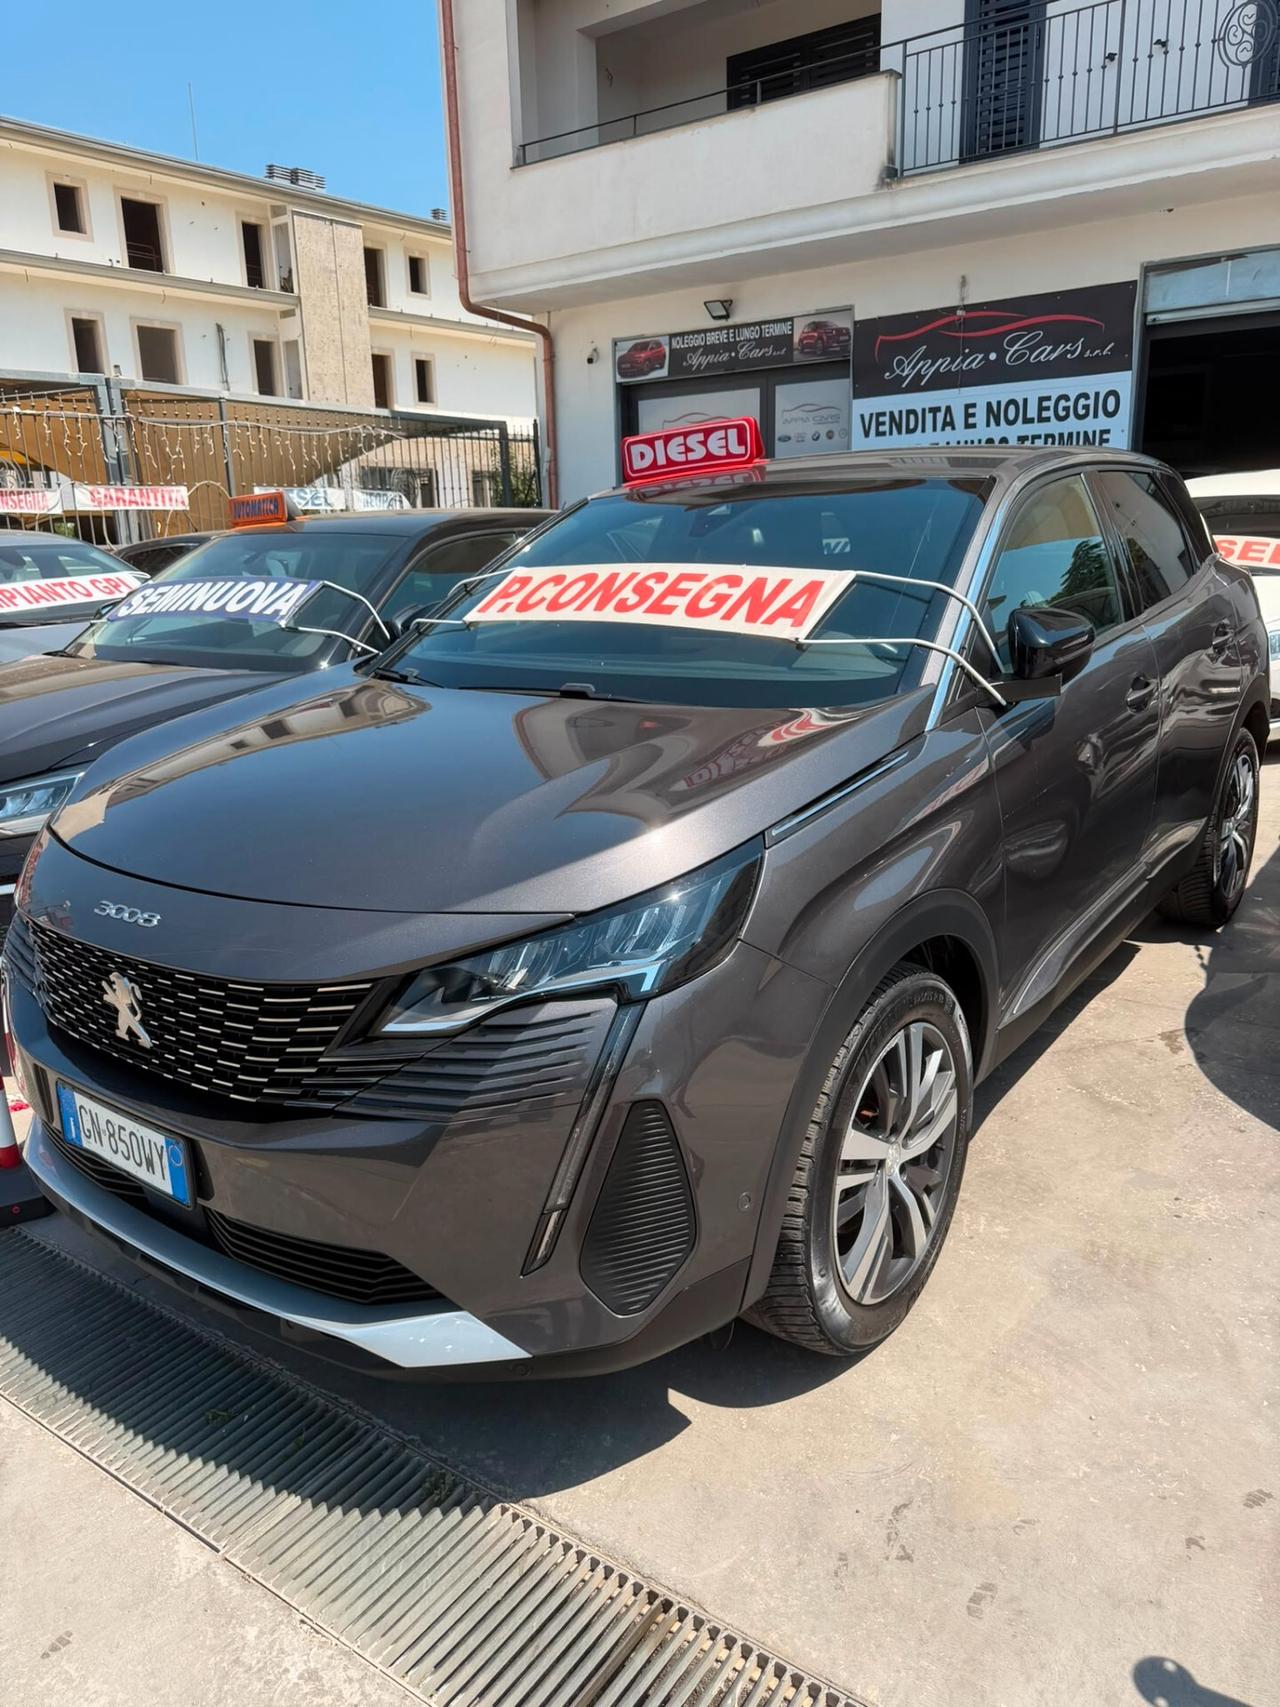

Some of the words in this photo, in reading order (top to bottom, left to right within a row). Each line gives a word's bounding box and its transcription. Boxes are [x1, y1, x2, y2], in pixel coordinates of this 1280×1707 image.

[672, 334, 705, 349] NOLEGGIO
[706, 330, 728, 345] BREVE
[729, 329, 735, 342] E
[736, 326, 760, 341] LUNGO
[761, 321, 792, 337] TERMINE
[1003, 331, 1084, 365] Cars
[860, 405, 956, 438] VENDITA
[964, 402, 977, 430] E
[986, 389, 1121, 428] NOLEGGIO
[630, 428, 746, 470] DIESEL
[117, 581, 308, 617] SEMINUOVA
[476, 571, 825, 628] P.CONSEGNA
[94, 900, 161, 927] 3008
